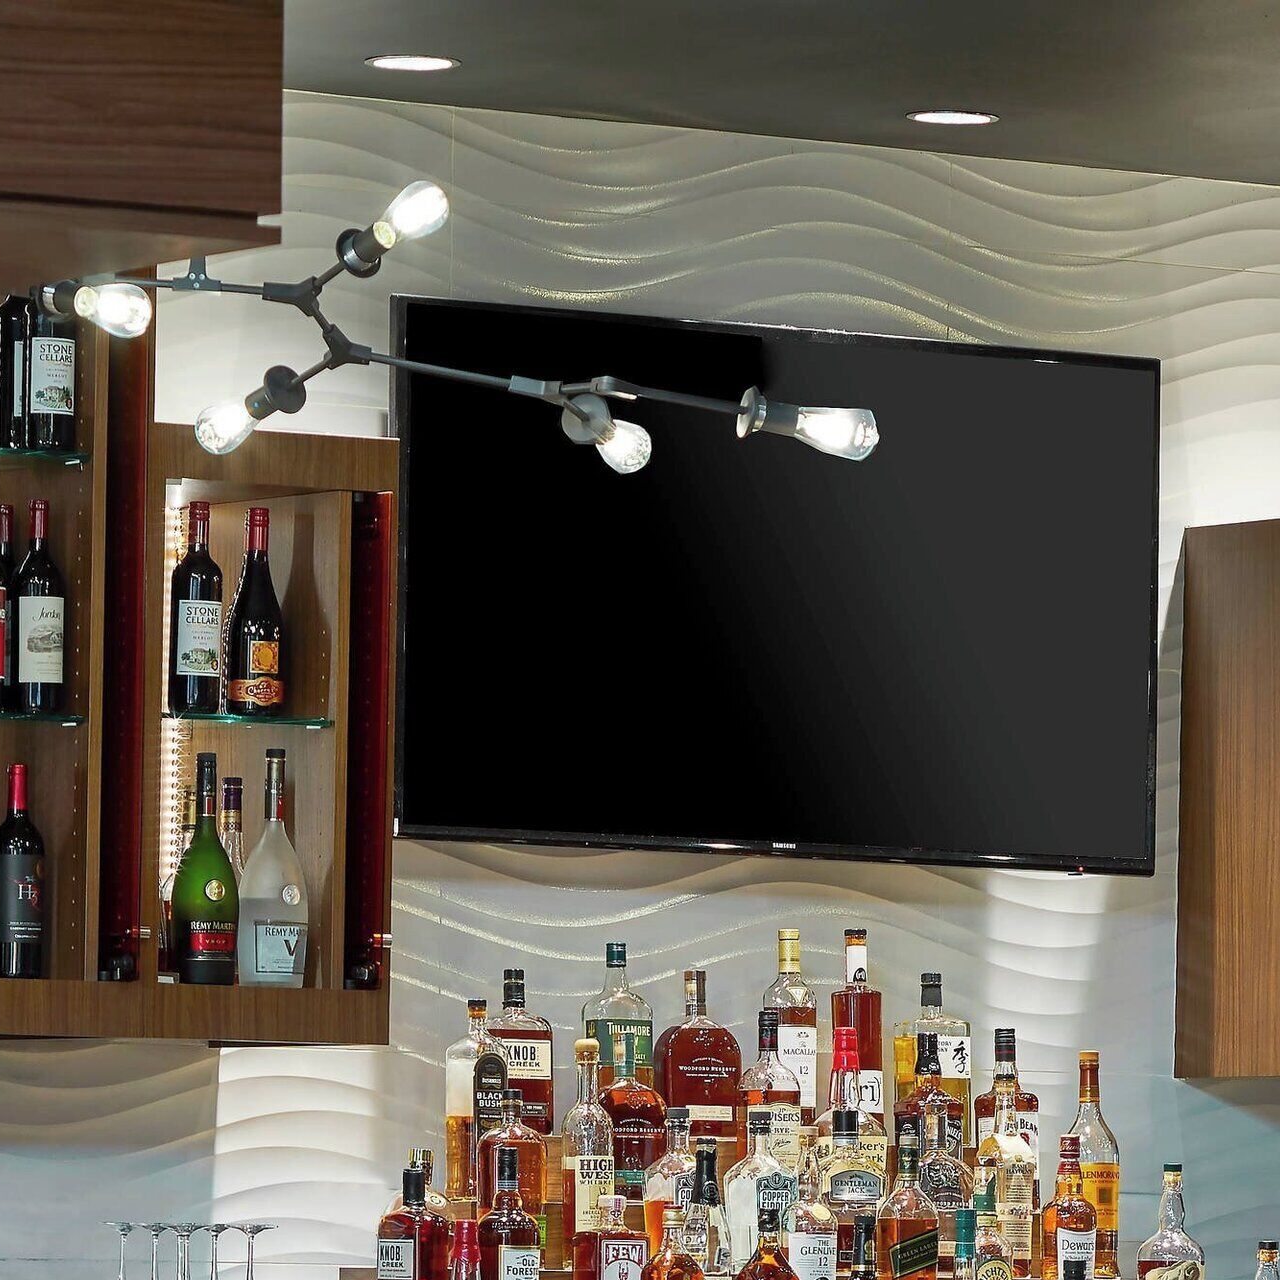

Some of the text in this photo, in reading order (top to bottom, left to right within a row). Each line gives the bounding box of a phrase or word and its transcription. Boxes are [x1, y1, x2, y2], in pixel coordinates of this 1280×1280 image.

[40, 344, 72, 354] STONE
[39, 353, 72, 363] CELLARS
[187, 607, 218, 617] STONE
[186, 617, 219, 625] CELLARS
[507, 1045, 536, 1060] KNOB
[798, 1066, 809, 1075] 12
[478, 1099, 502, 1107] BUSH
[860, 1142, 885, 1151] ker's
[834, 1179, 878, 1187] GENTLEMAN
[848, 1186, 865, 1194] JACK
[762, 1190, 789, 1201] COPPER
[1061, 1239, 1095, 1250] Dewar's
[380, 1244, 401, 1261] KNOB
[608, 1244, 641, 1260] FEW
[522, 1258, 535, 1267] OLD
[818, 1257, 828, 1267] 12
